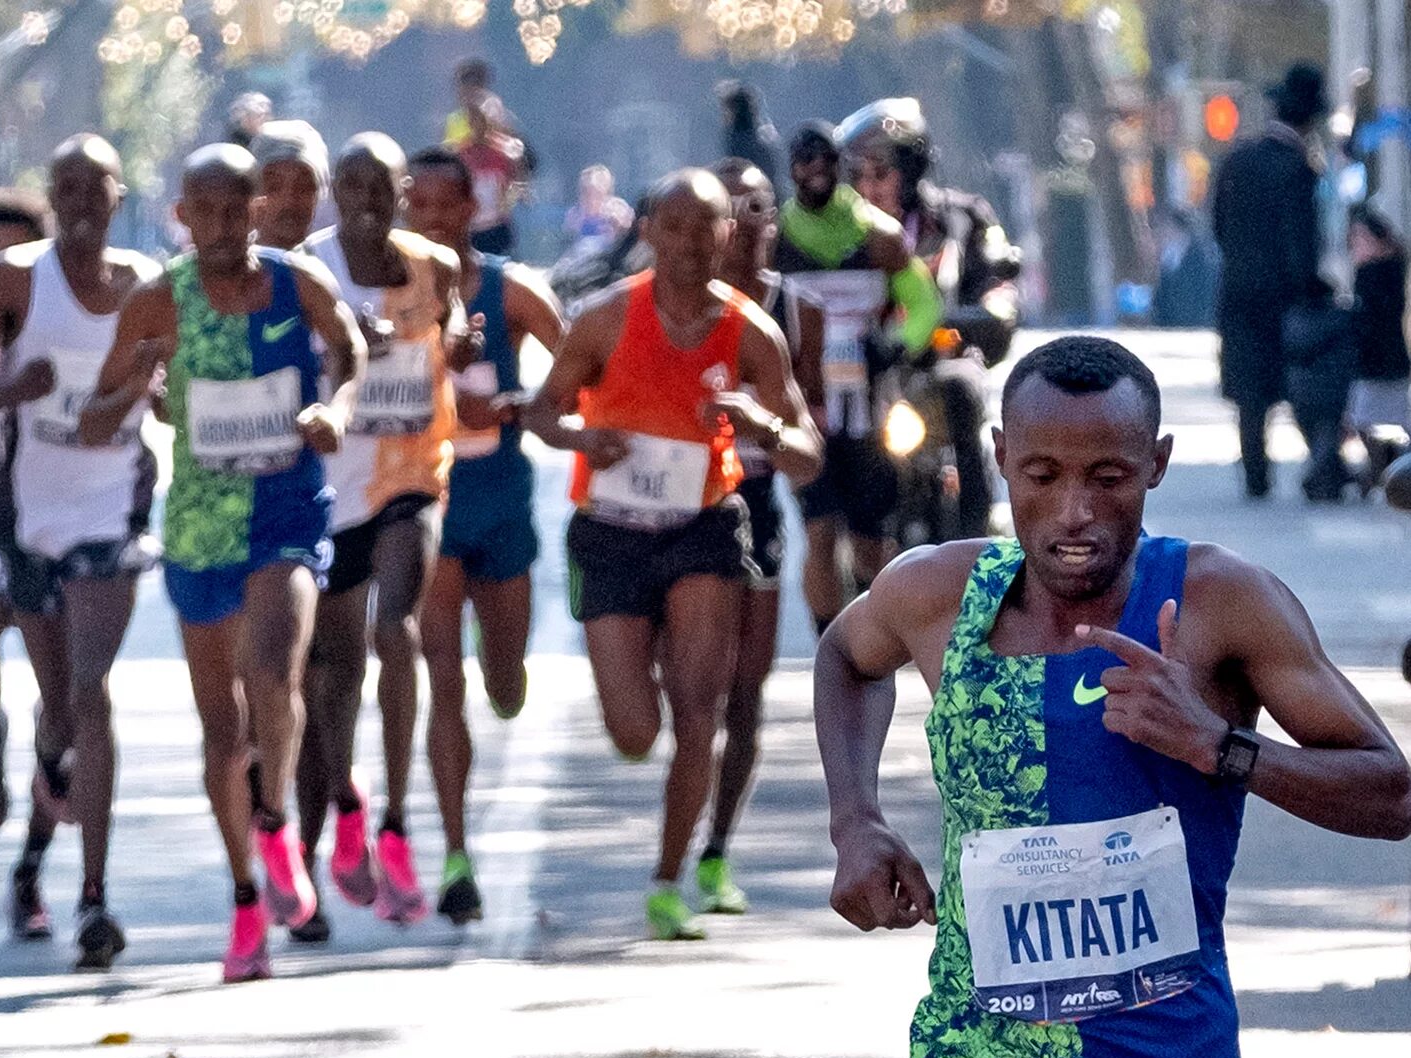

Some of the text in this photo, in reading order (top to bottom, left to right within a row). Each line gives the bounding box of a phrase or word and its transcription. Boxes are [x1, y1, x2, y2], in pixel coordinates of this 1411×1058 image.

[1021, 836, 1058, 848] TATA
[999, 848, 1083, 864] CONSULTANCY
[1102, 851, 1141, 866] TATA
[1016, 862, 1070, 876] SERVICES
[1003, 889, 1159, 965] KITATA
[988, 994, 1035, 1013] 2019
